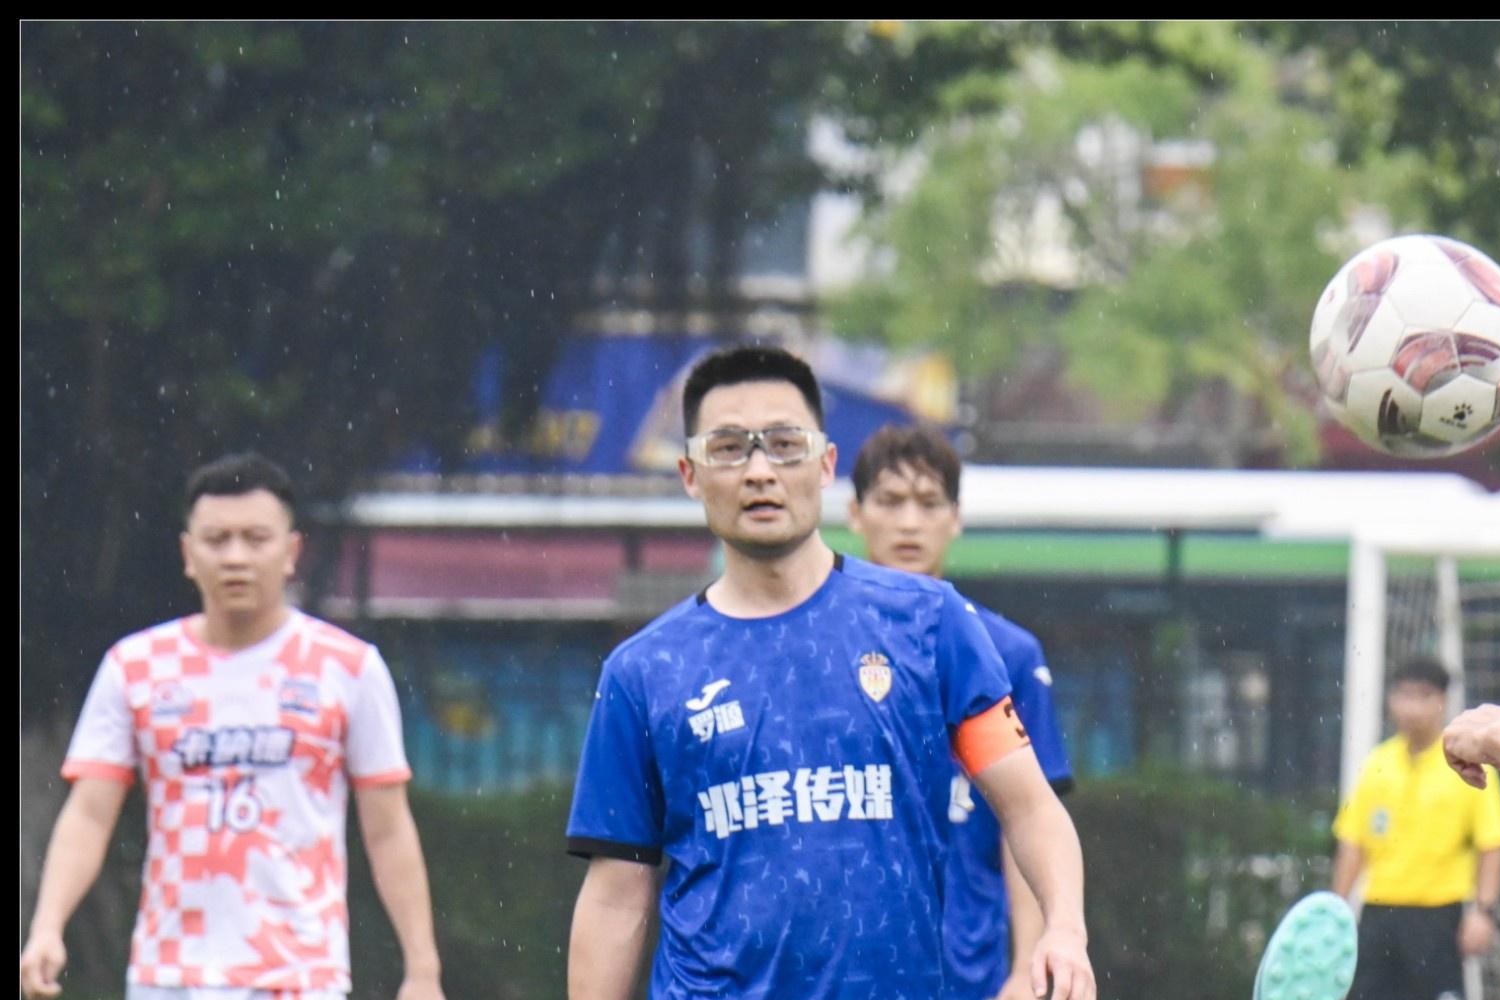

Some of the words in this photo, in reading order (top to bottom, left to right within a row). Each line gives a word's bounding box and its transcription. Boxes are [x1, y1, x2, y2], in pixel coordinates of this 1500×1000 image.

[189, 774, 264, 833] 16
[697, 763, 894, 840] 兆泽传媒
